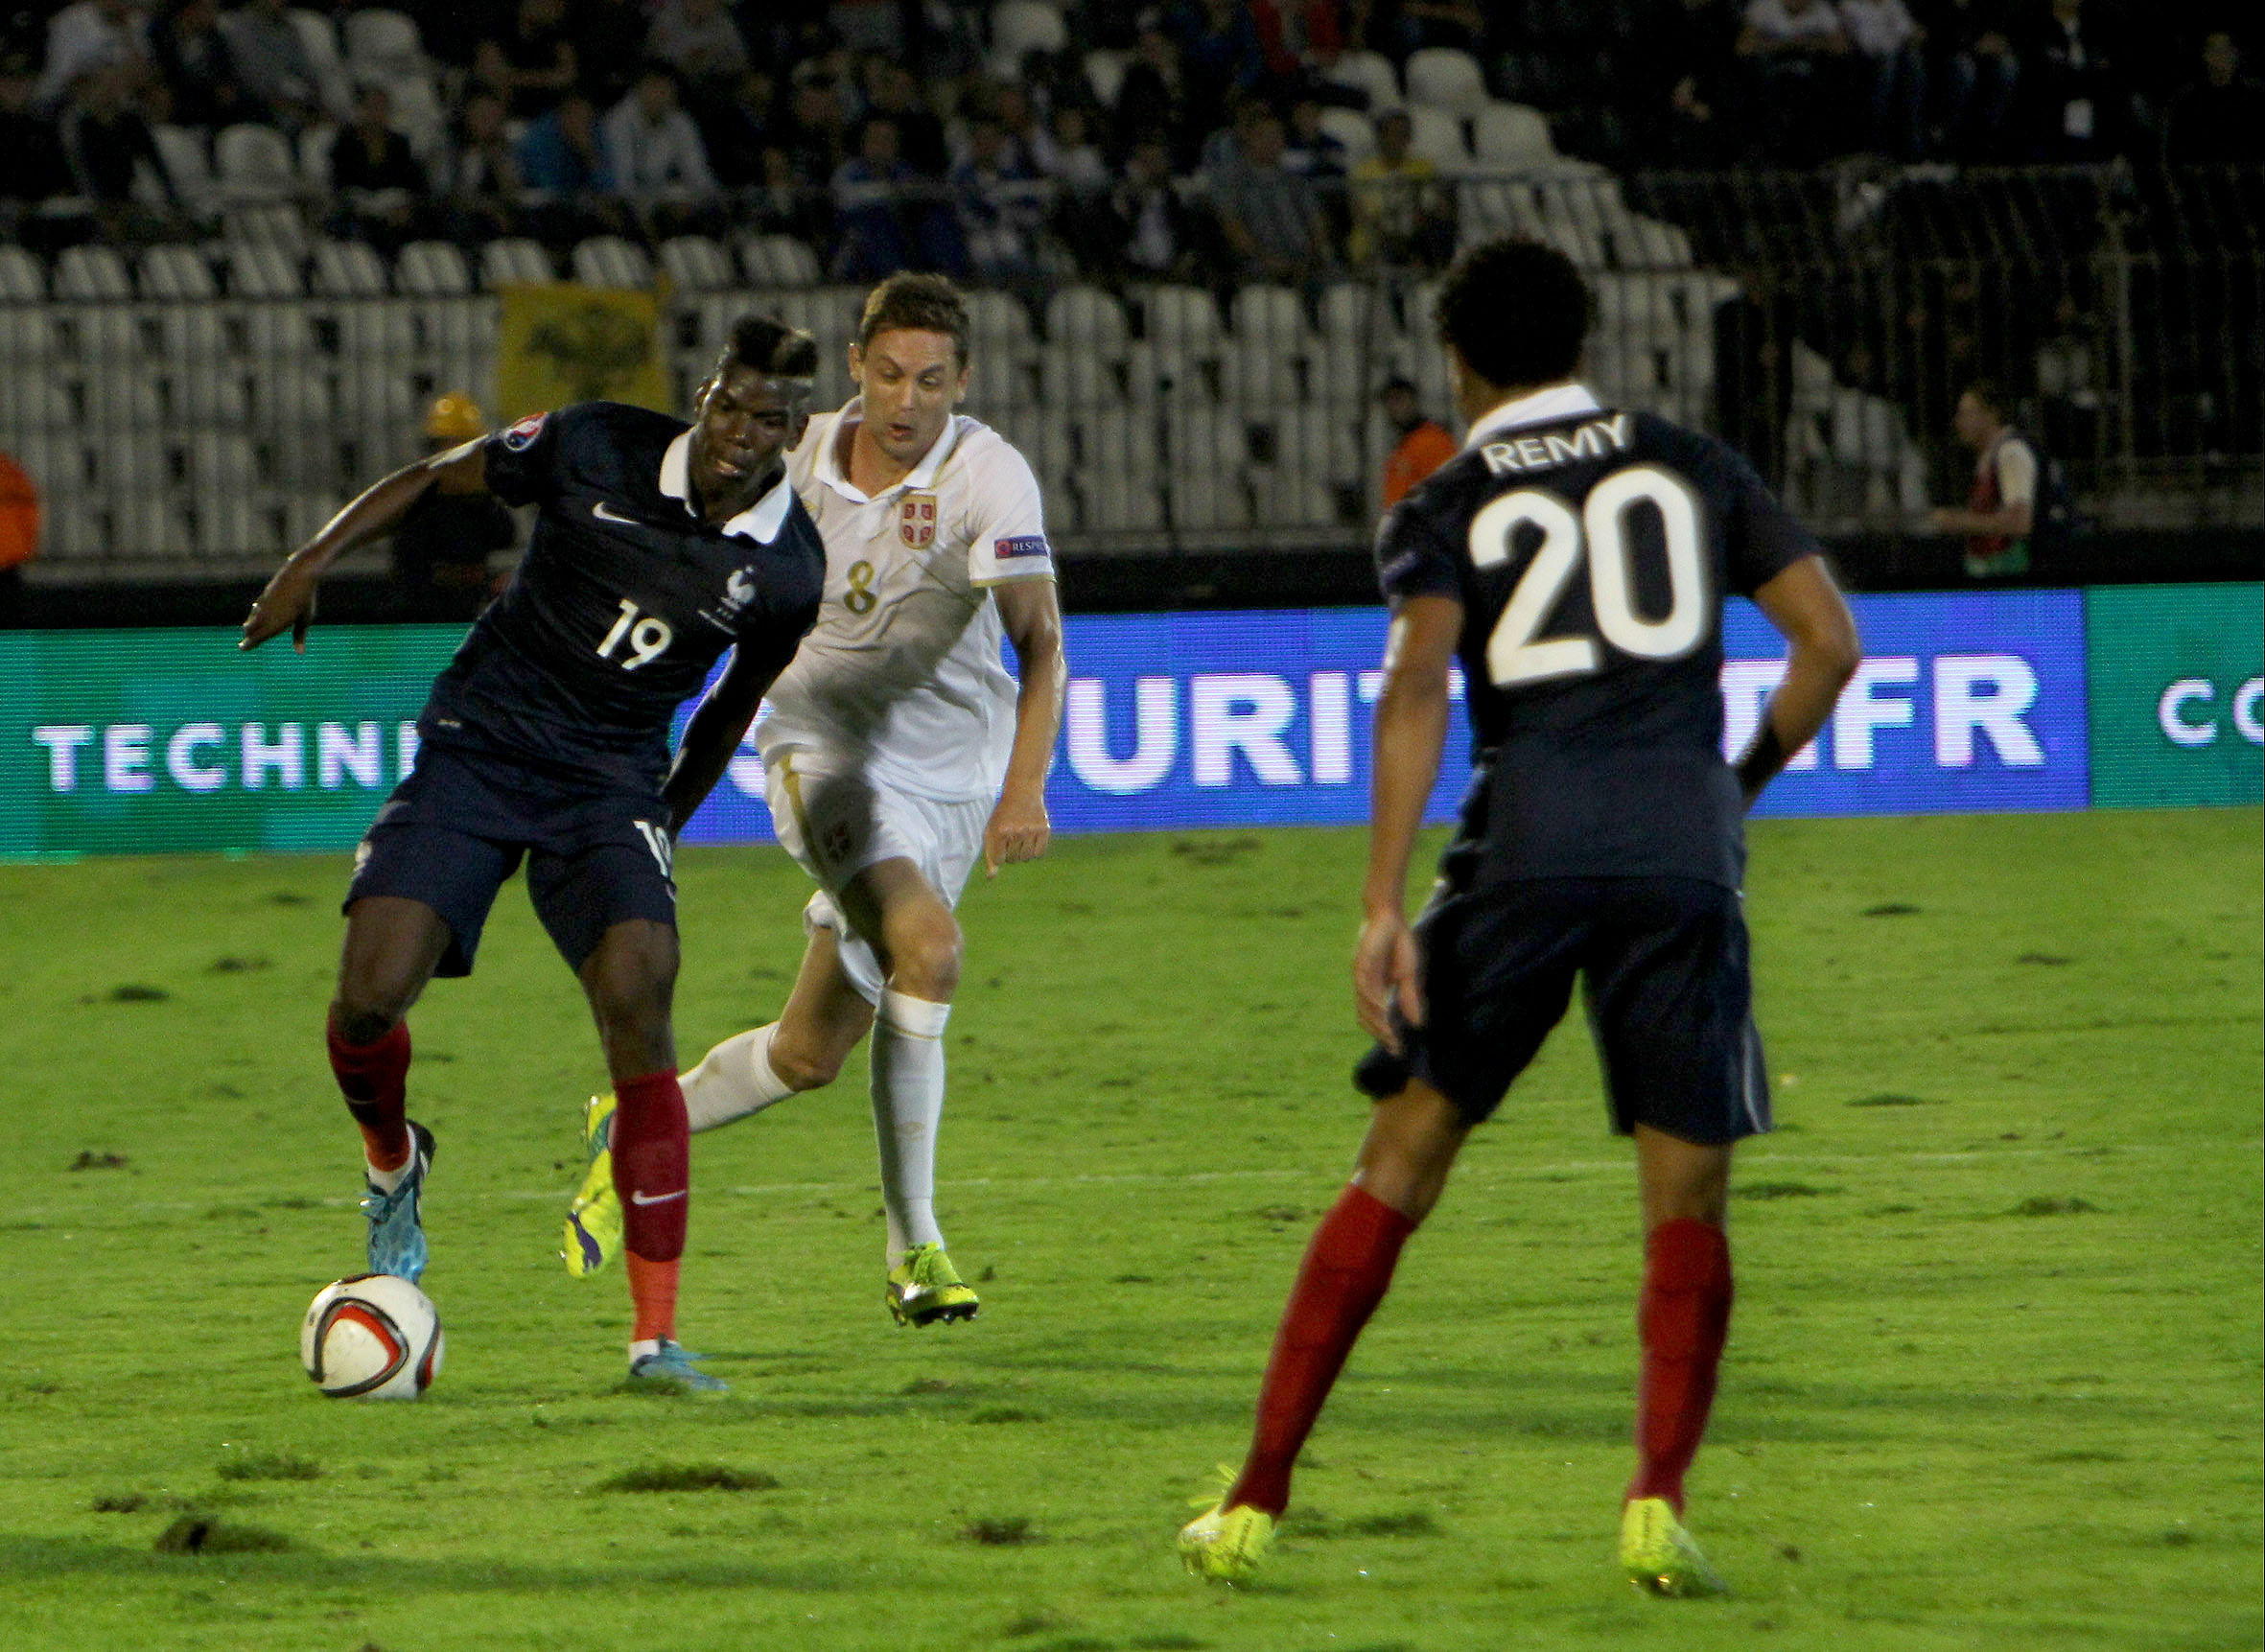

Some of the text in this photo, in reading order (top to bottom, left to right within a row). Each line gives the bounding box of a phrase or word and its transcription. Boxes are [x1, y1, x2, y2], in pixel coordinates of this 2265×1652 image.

[1483, 413, 1628, 474] REMY
[844, 560, 877, 615] 8
[1468, 467, 1704, 686] 20
[595, 598, 672, 670] 19
